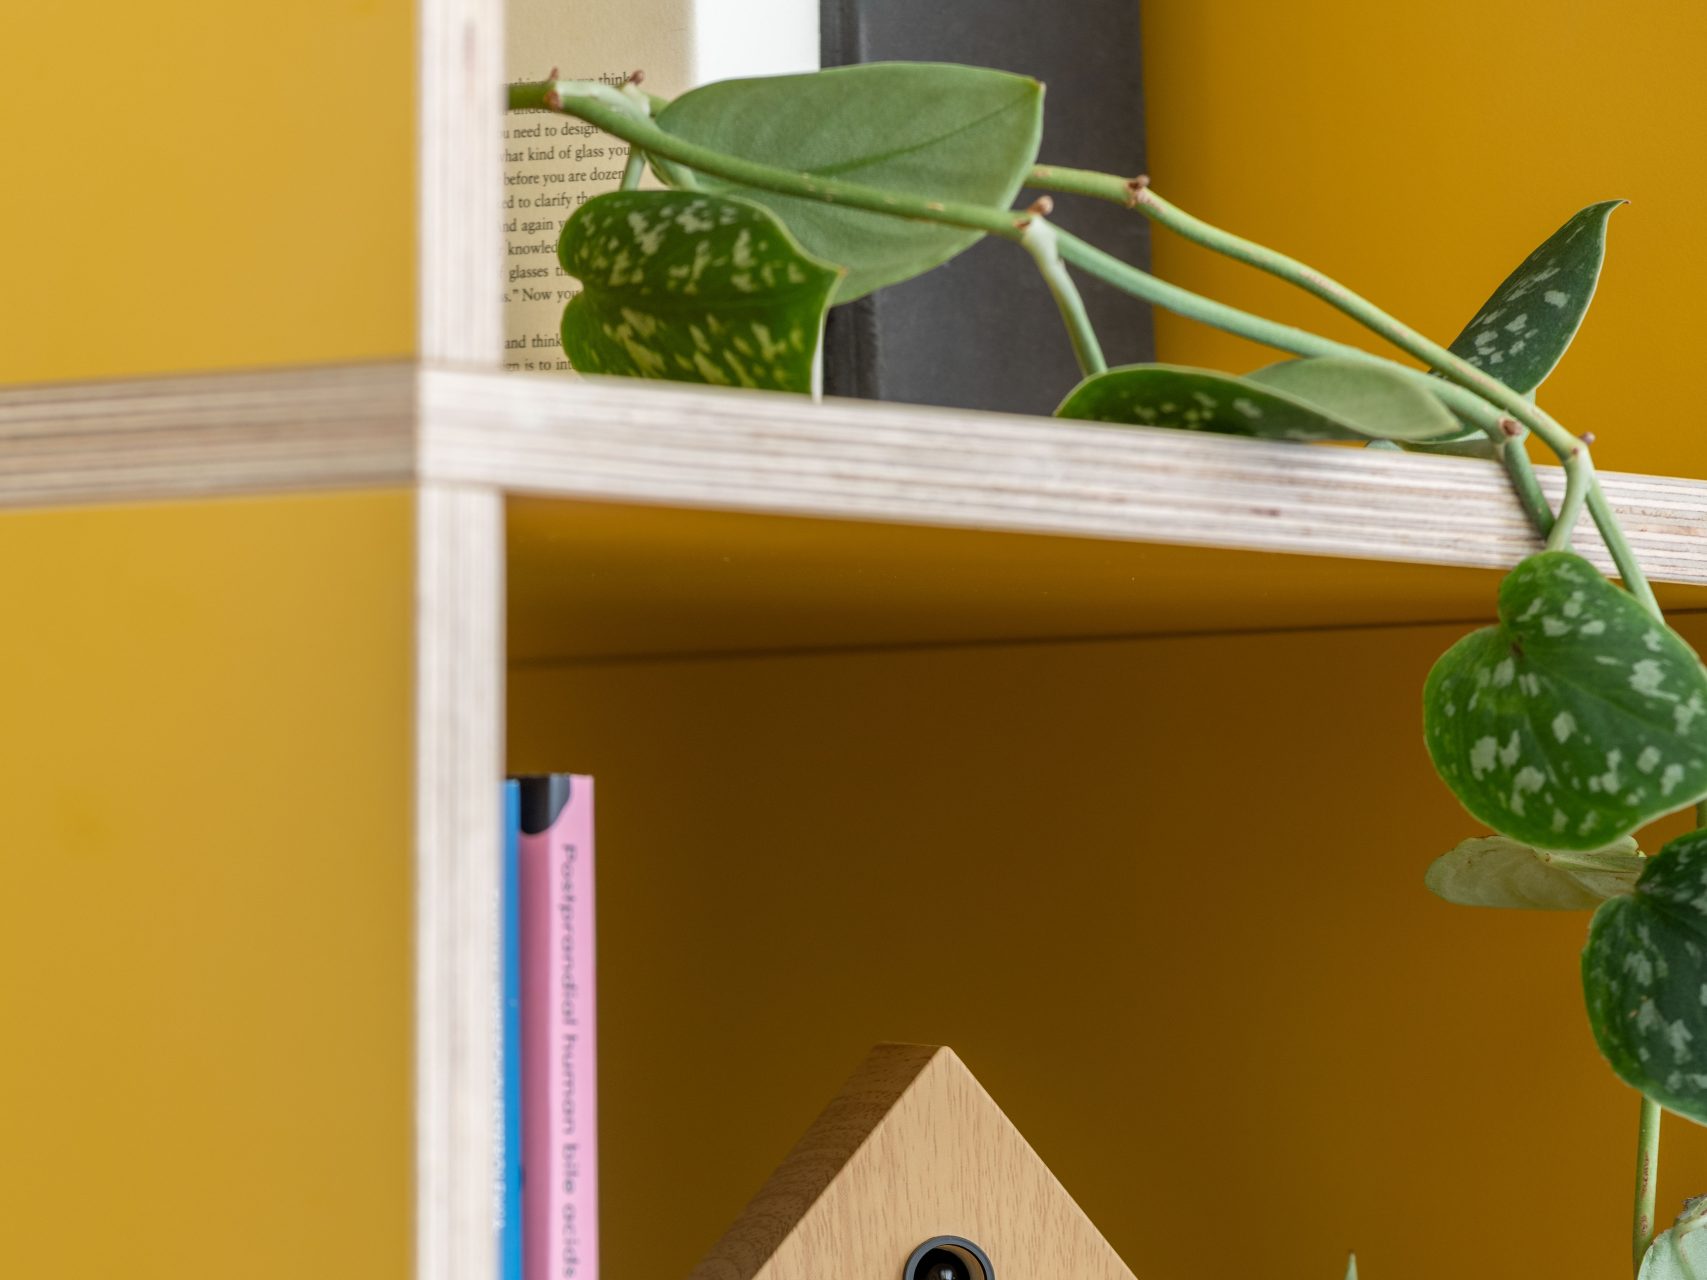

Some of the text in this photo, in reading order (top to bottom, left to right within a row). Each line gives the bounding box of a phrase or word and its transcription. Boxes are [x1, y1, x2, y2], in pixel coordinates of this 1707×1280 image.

[513, 123, 541, 138] need
[545, 127, 557, 136] to
[561, 122, 599, 138] design
[503, 148, 523, 162] hat
[528, 146, 554, 161] kind
[558, 144, 572, 159] of
[575, 144, 604, 161] glass
[503, 170, 539, 185] before
[541, 173, 565, 187] you
[567, 172, 587, 182] are
[518, 198, 531, 208] to
[534, 191, 572, 209] clarify
[577, 191, 593, 205] th
[502, 218, 517, 232] nd
[521, 217, 553, 235] again
[509, 264, 549, 282] glasses
[522, 287, 552, 302] Now
[504, 333, 562, 349] and think
[525, 358, 534, 371] is
[539, 361, 552, 371] to
[559, 843, 578, 1025] Postprandial
[561, 1033, 578, 1136] human
